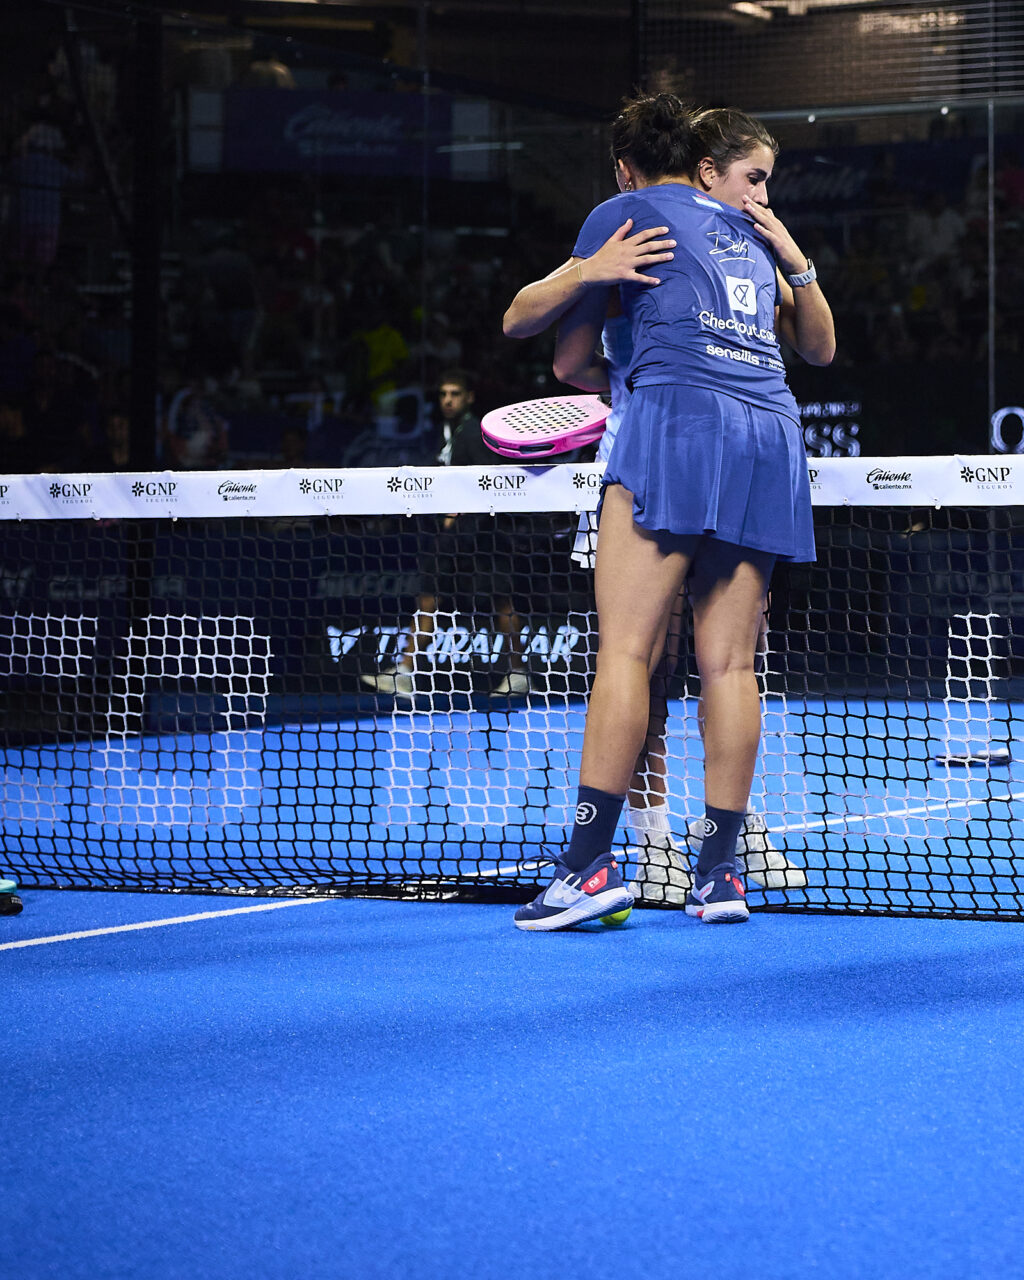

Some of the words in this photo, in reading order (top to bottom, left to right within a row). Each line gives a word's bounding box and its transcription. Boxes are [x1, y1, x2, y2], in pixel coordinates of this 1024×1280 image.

[706, 344, 760, 366] sensilis
[866, 468, 912, 484] Caliente
[975, 466, 1013, 482] GNP
[61, 483, 92, 497] GNP
[145, 482, 177, 496] GNP
[217, 480, 257, 495] Caliente
[312, 478, 345, 493] GNP
[403, 477, 435, 491] GNP
[492, 475, 527, 490] GNP
